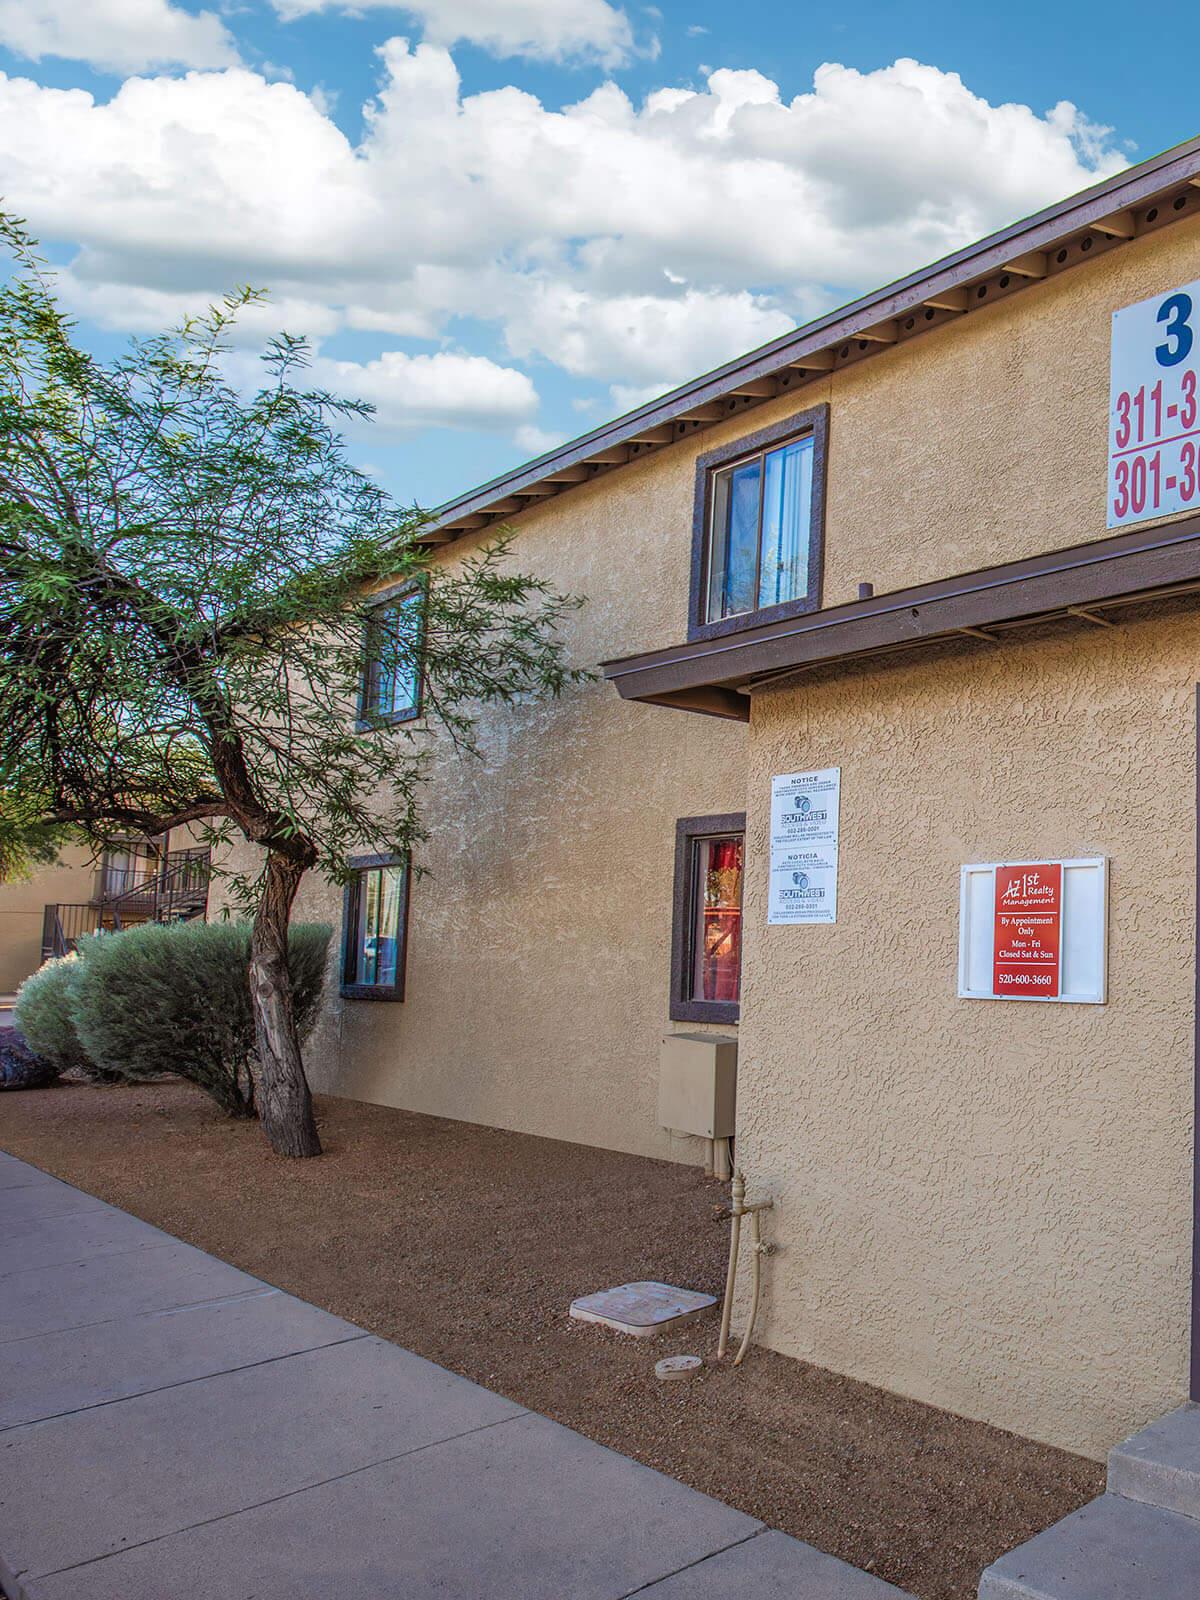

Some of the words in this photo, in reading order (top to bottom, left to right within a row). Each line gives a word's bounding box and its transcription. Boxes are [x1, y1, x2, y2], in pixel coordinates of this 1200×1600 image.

[1155, 293, 1193, 367] 3
[791, 776, 818, 784] NOTICE
[1028, 886, 1054, 897] Realty
[1002, 897, 1055, 907] Management
[1001, 917, 1009, 927] By
[1010, 917, 1053, 927] Appointment
[1018, 927, 1035, 936] Only
[1011, 940, 1026, 948] Mon
[1031, 940, 1041, 948] Fri
[999, 950, 1021, 958] Closed
[1040, 951, 1053, 959] Sun
[998, 974, 1052, 985] 520-600-3660
